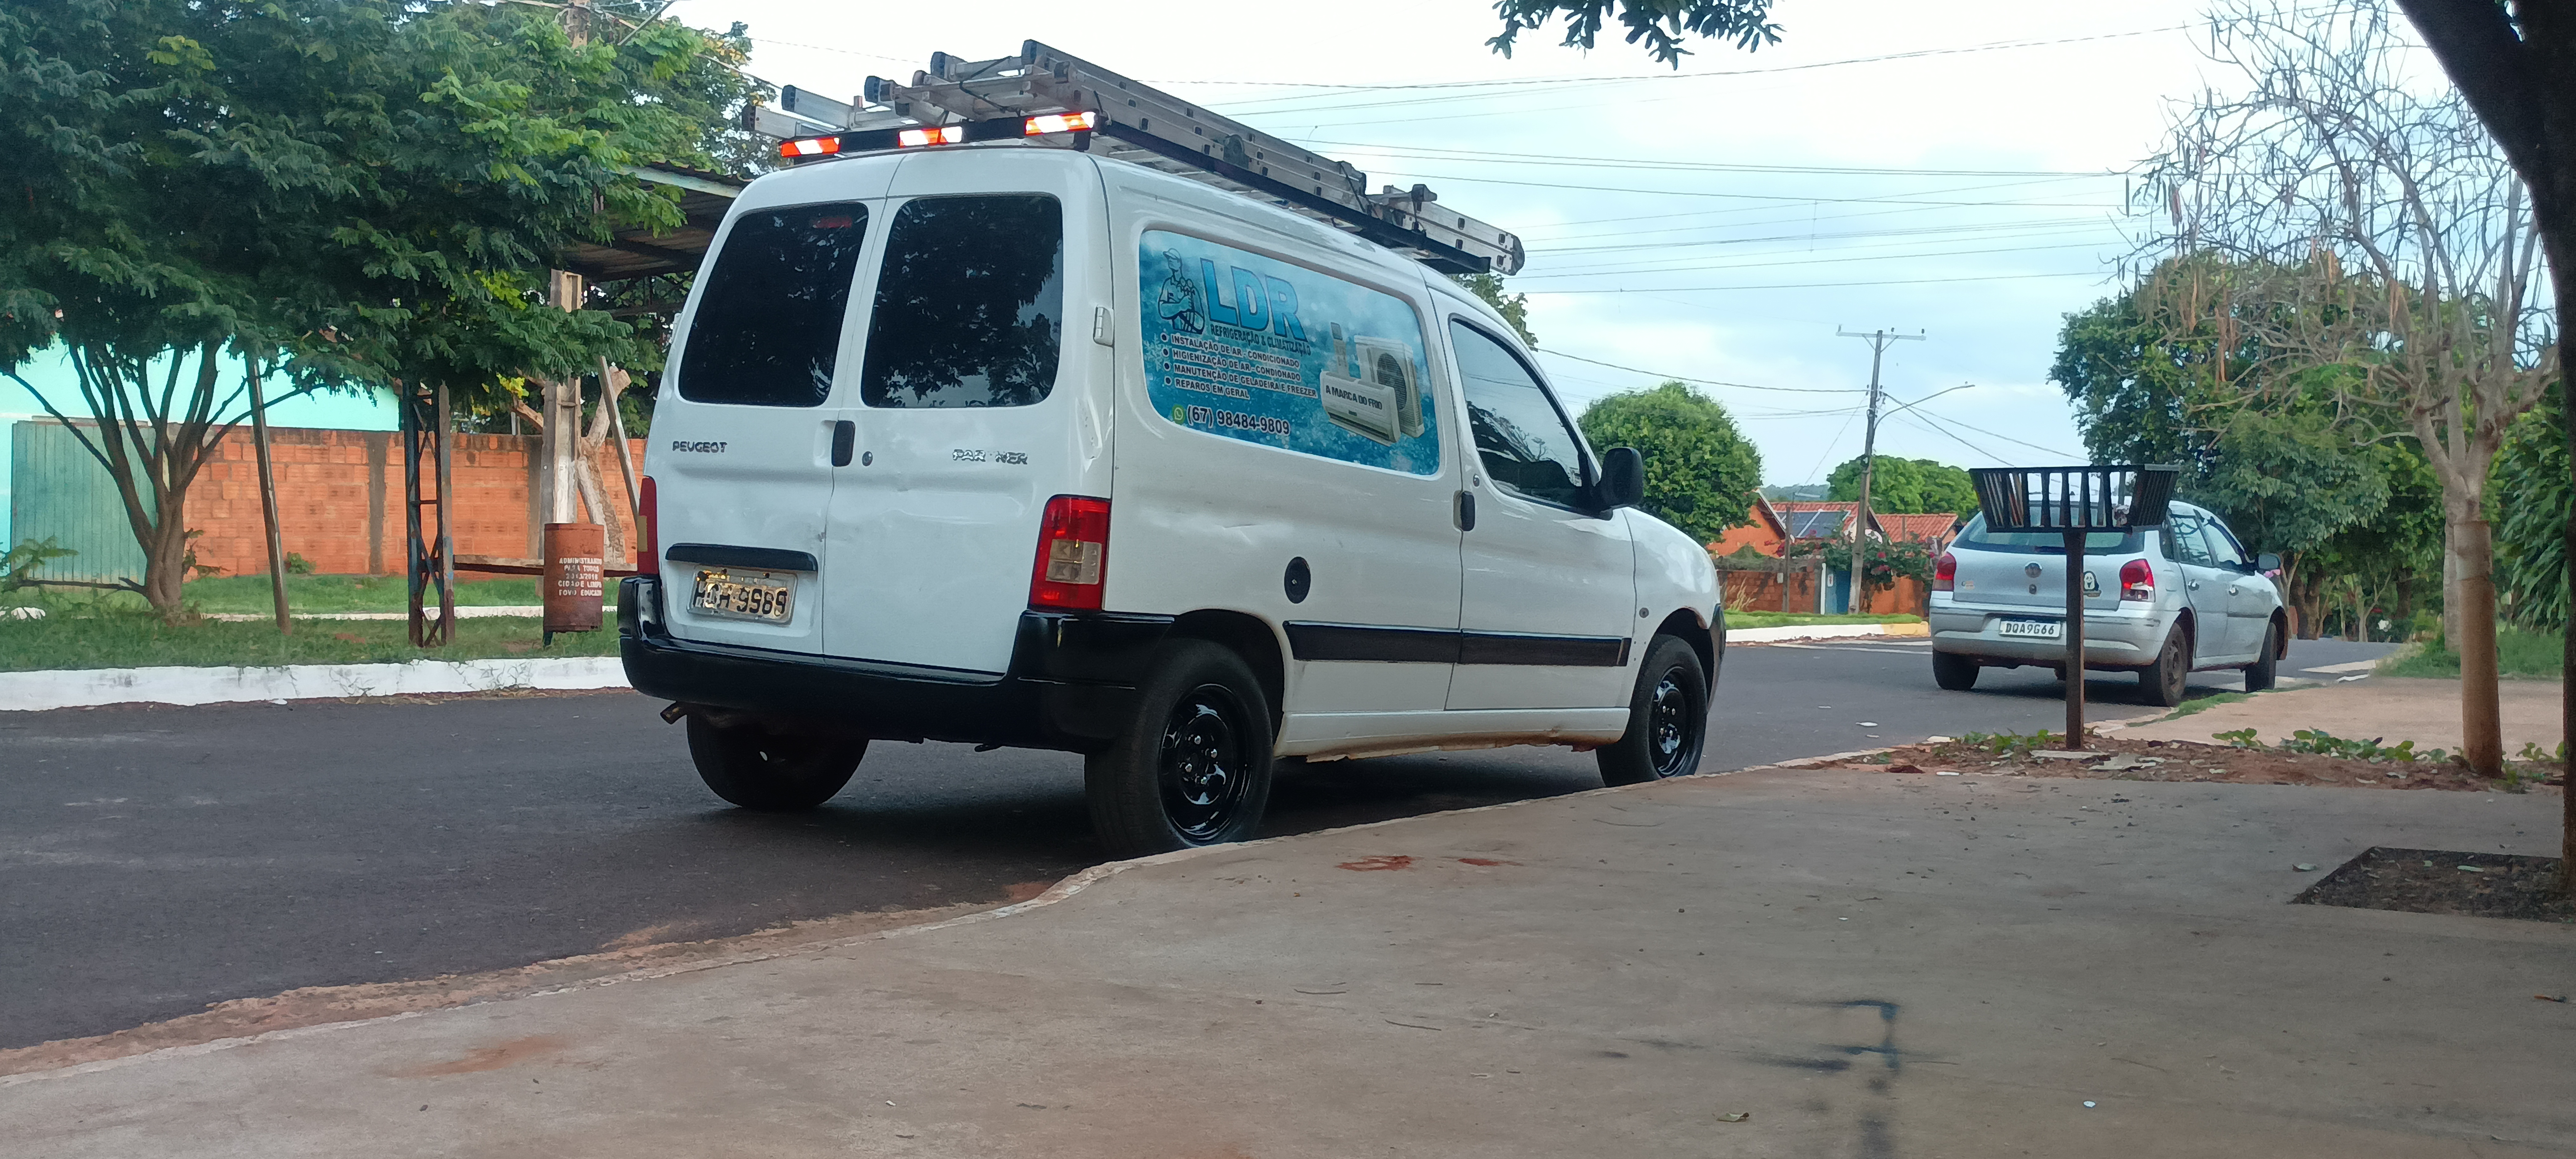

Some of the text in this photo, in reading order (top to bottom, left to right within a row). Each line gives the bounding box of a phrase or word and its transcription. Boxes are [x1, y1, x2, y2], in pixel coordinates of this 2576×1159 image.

[1200, 257, 1308, 342] LDR
[1210, 324, 1259, 346] REFRIGERAÇÃO
[1172, 335, 1219, 351] INSTALAÇÃO
[1221, 345, 1230, 354] DE
[1232, 347, 1242, 356] AR
[1248, 351, 1299, 368] CONDICIONADO
[1173, 349, 1227, 366] HIGIENIZAÇÃO
[1229, 360, 1239, 369] DE
[1241, 363, 1251, 371] AR
[1256, 366, 1301, 381] CONDIONADO
[1174, 364, 1227, 380] MANUTENÇÃO
[1241, 376, 1279, 390] GELADEIRA
[1287, 385, 1316, 397] FREEZER
[1176, 378, 1249, 398] REPAROS EM GERAL
[1326, 385, 1382, 410] A MARCA DO FRIO
[1188, 406, 1290, 434] (67) 98484-9809
[672, 441, 727, 453] PEUGEOT
[2005, 622, 2054, 635] DQA9G66
